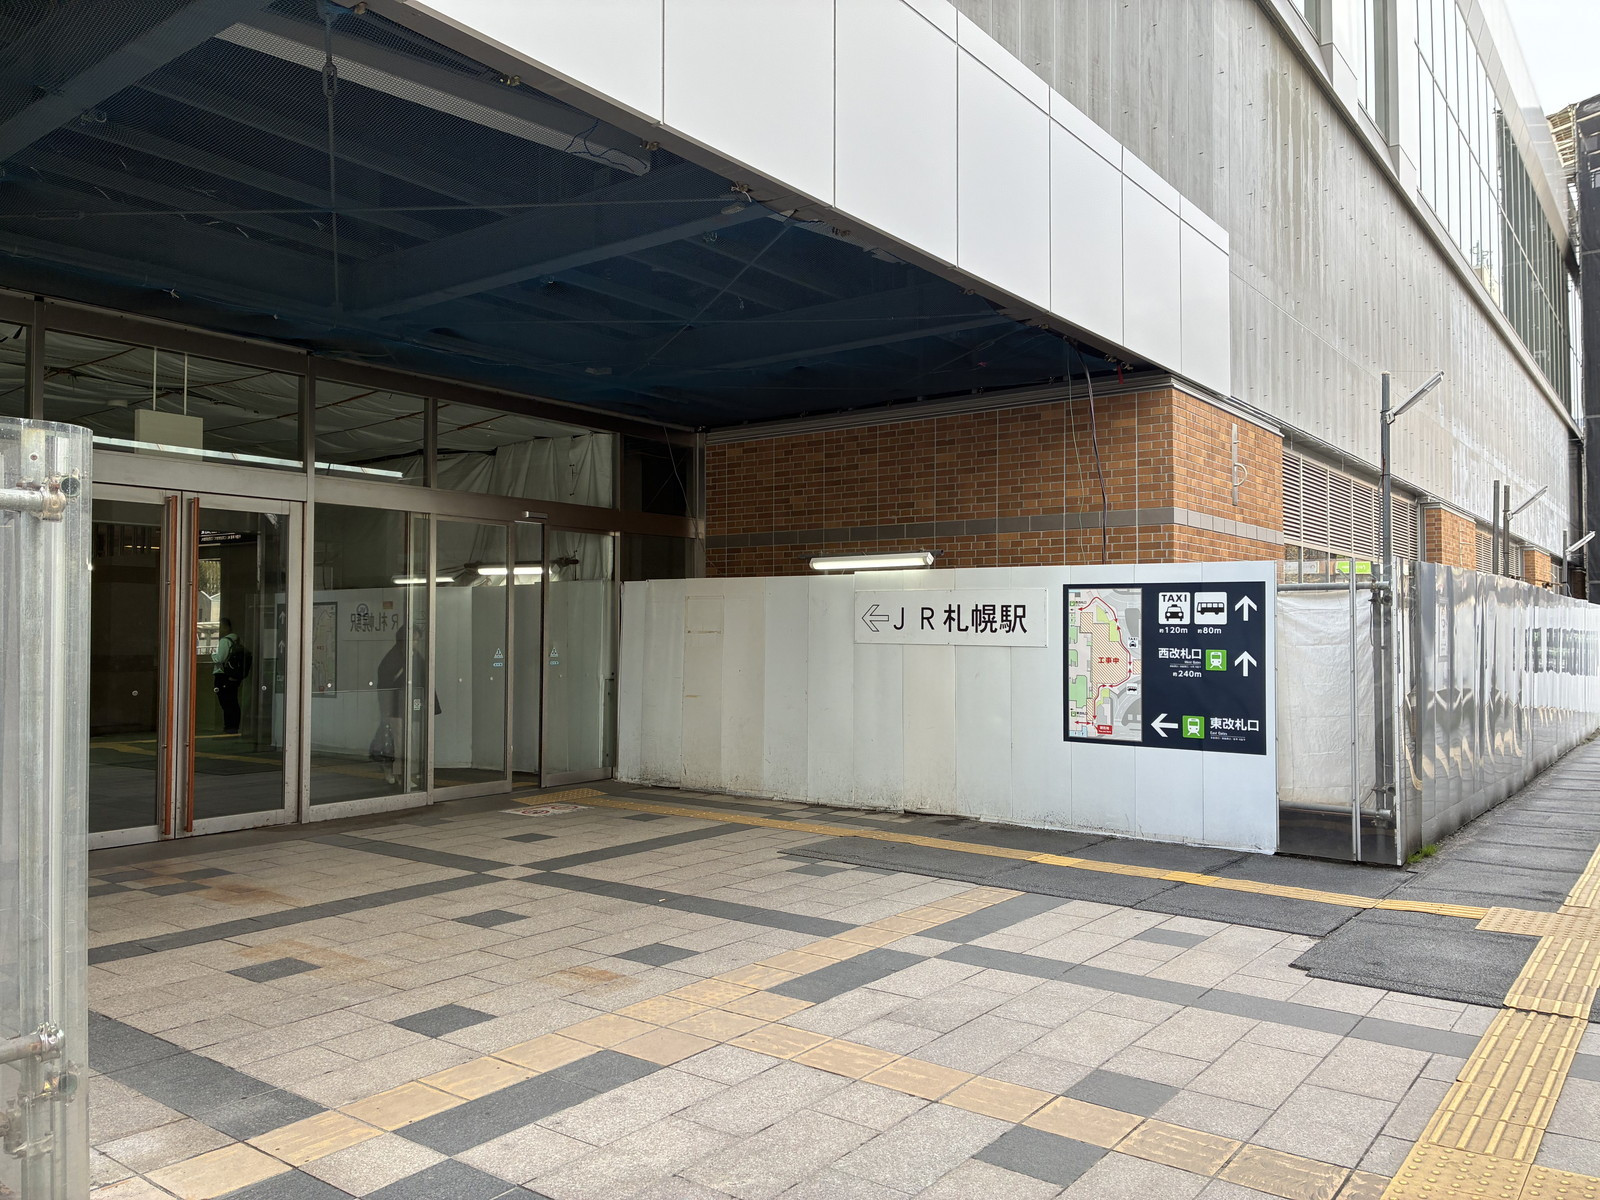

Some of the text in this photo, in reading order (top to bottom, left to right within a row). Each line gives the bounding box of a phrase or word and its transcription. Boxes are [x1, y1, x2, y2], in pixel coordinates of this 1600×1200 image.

[1161, 594, 1187, 603] TAXI
[1158, 647, 1202, 659] 西改札口
[1209, 716, 1259, 732] 東改札口
